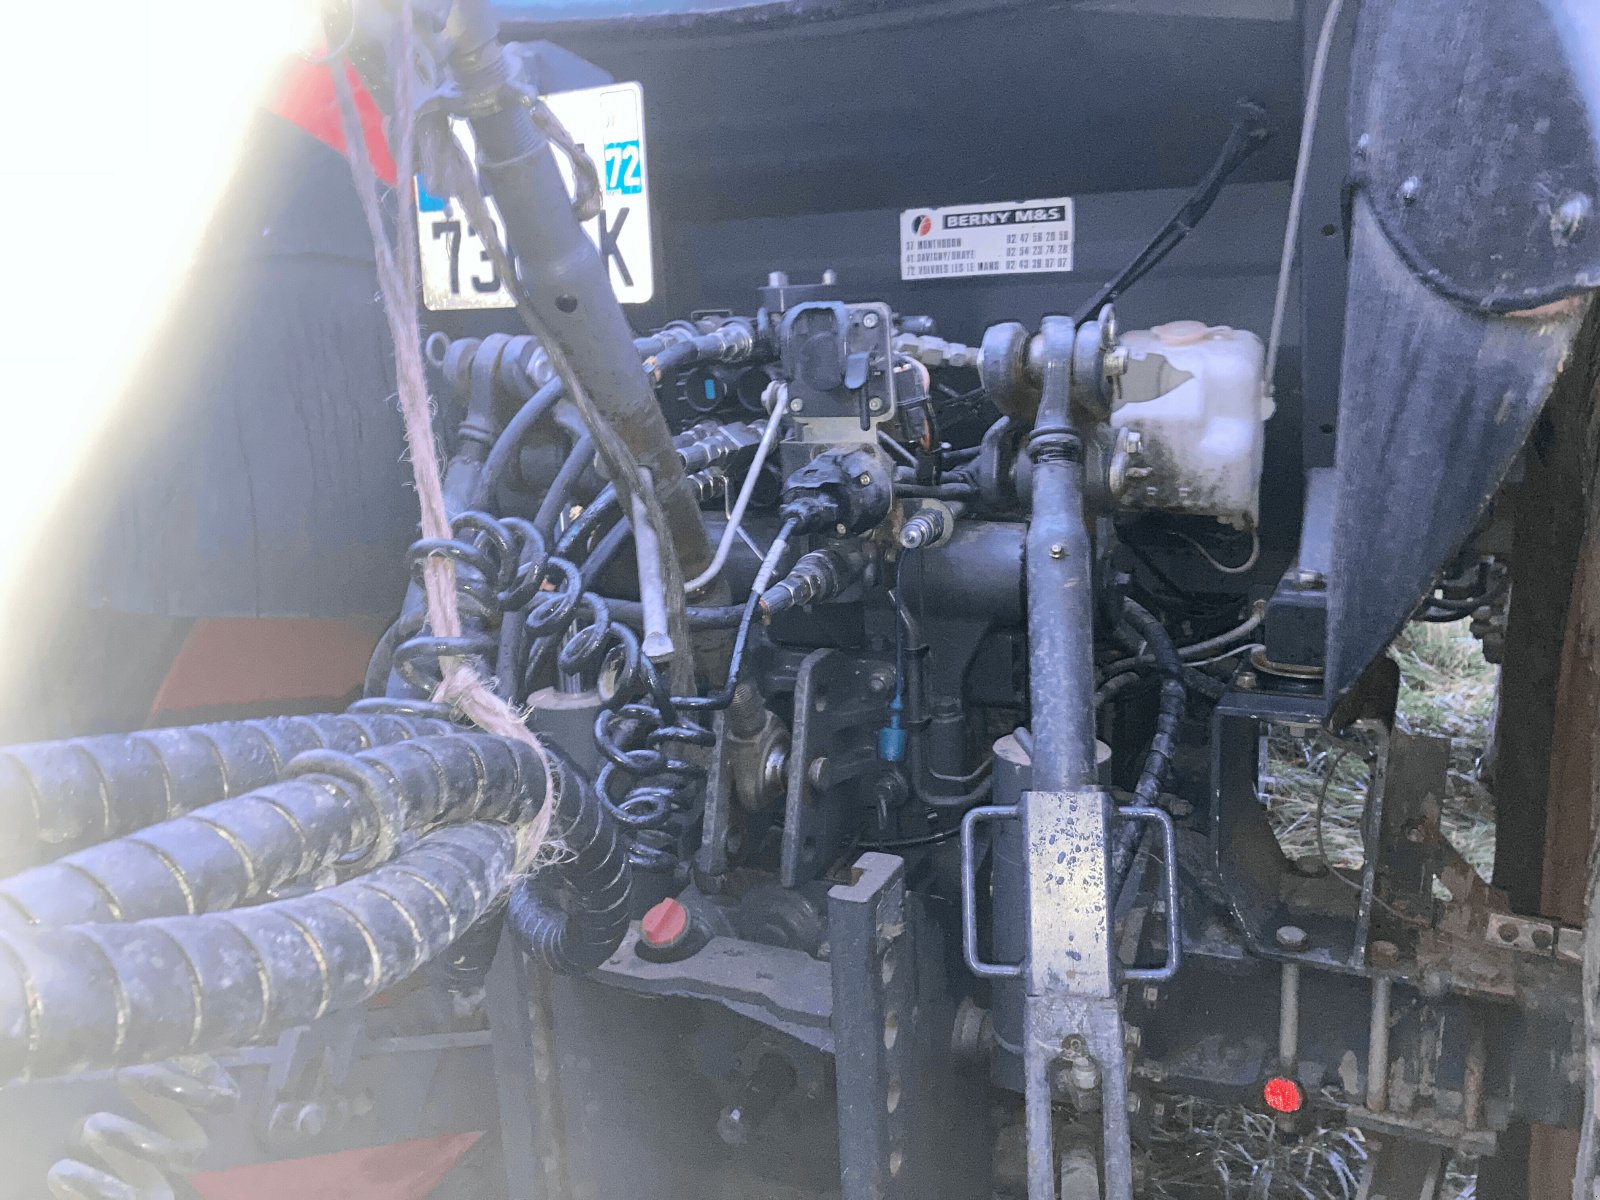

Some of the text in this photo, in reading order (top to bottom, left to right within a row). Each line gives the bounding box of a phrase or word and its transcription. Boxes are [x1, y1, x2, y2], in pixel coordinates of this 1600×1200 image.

[605, 146, 641, 188] 72
[947, 208, 1062, 227] BERNY M&S
